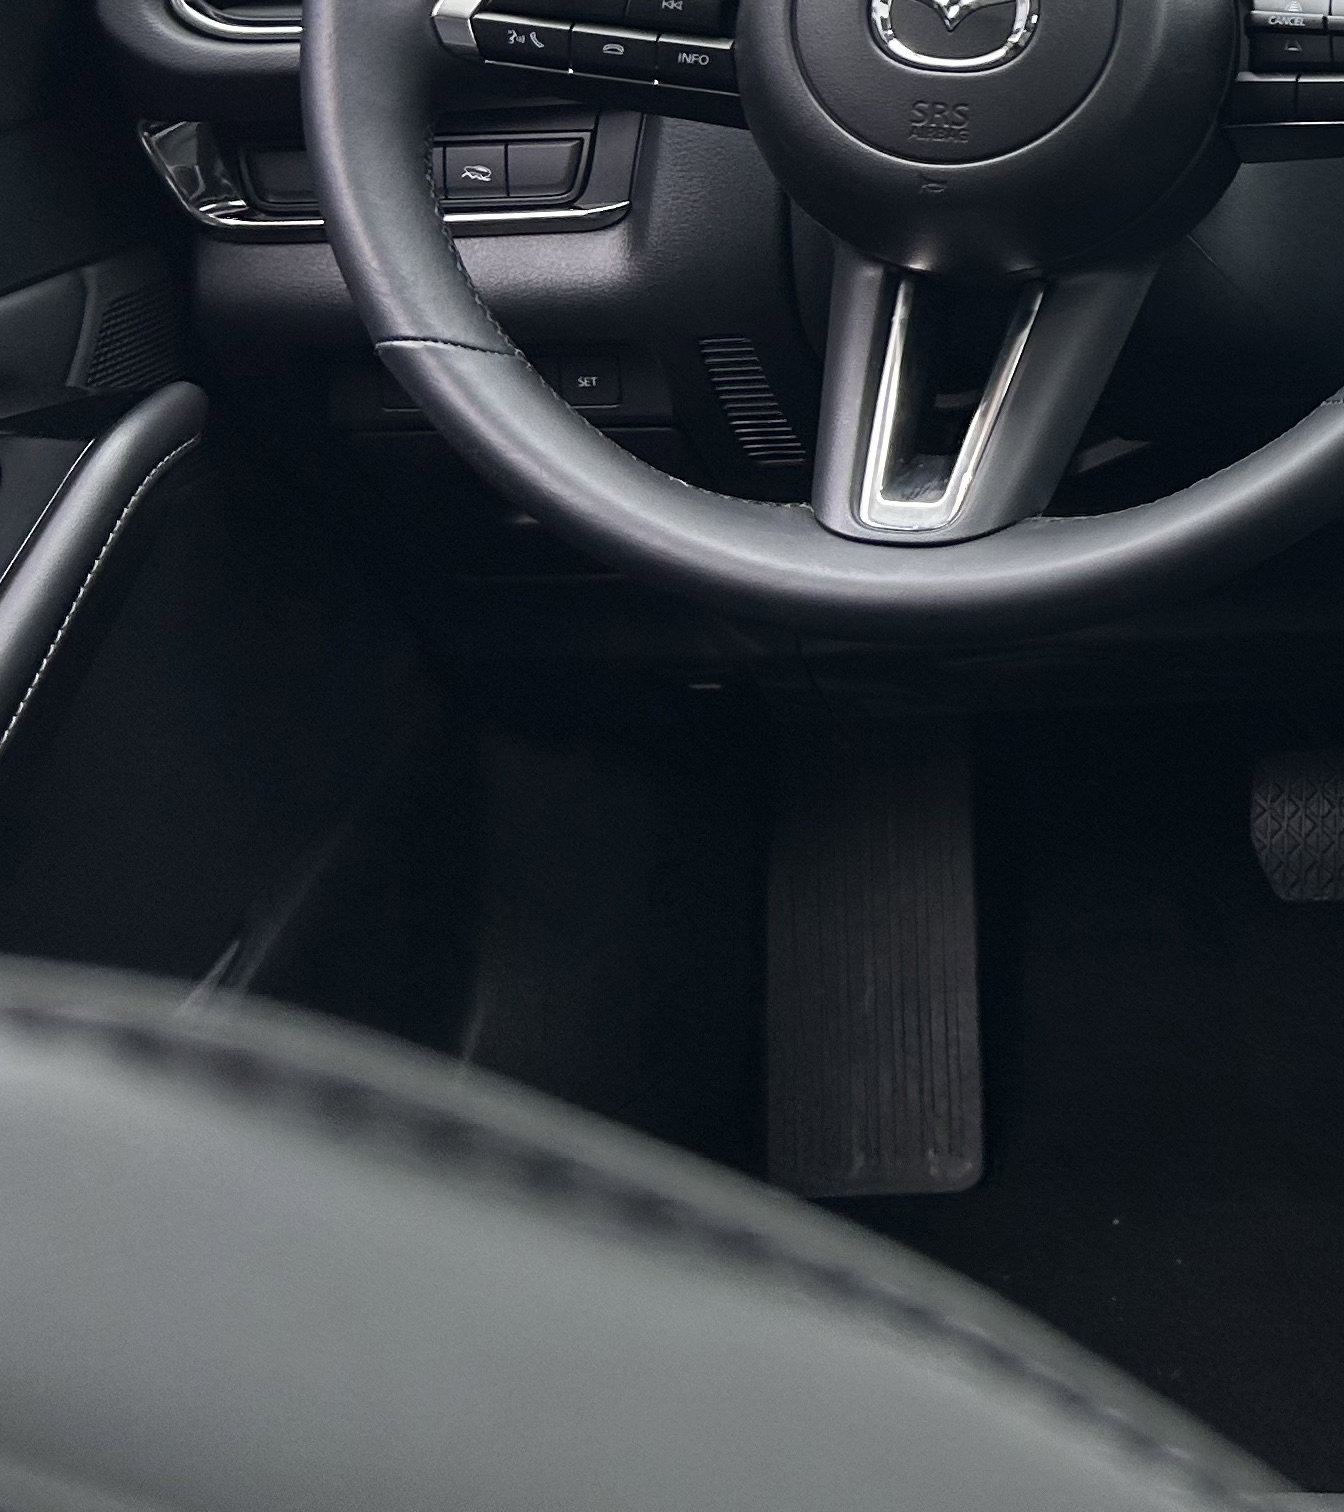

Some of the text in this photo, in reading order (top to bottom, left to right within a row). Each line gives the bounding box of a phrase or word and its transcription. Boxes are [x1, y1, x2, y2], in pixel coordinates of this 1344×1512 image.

[1268, 15, 1306, 27] CANCEL
[677, 51, 710, 66] INFO
[910, 101, 969, 129] SRS
[577, 376, 598, 387] SET
